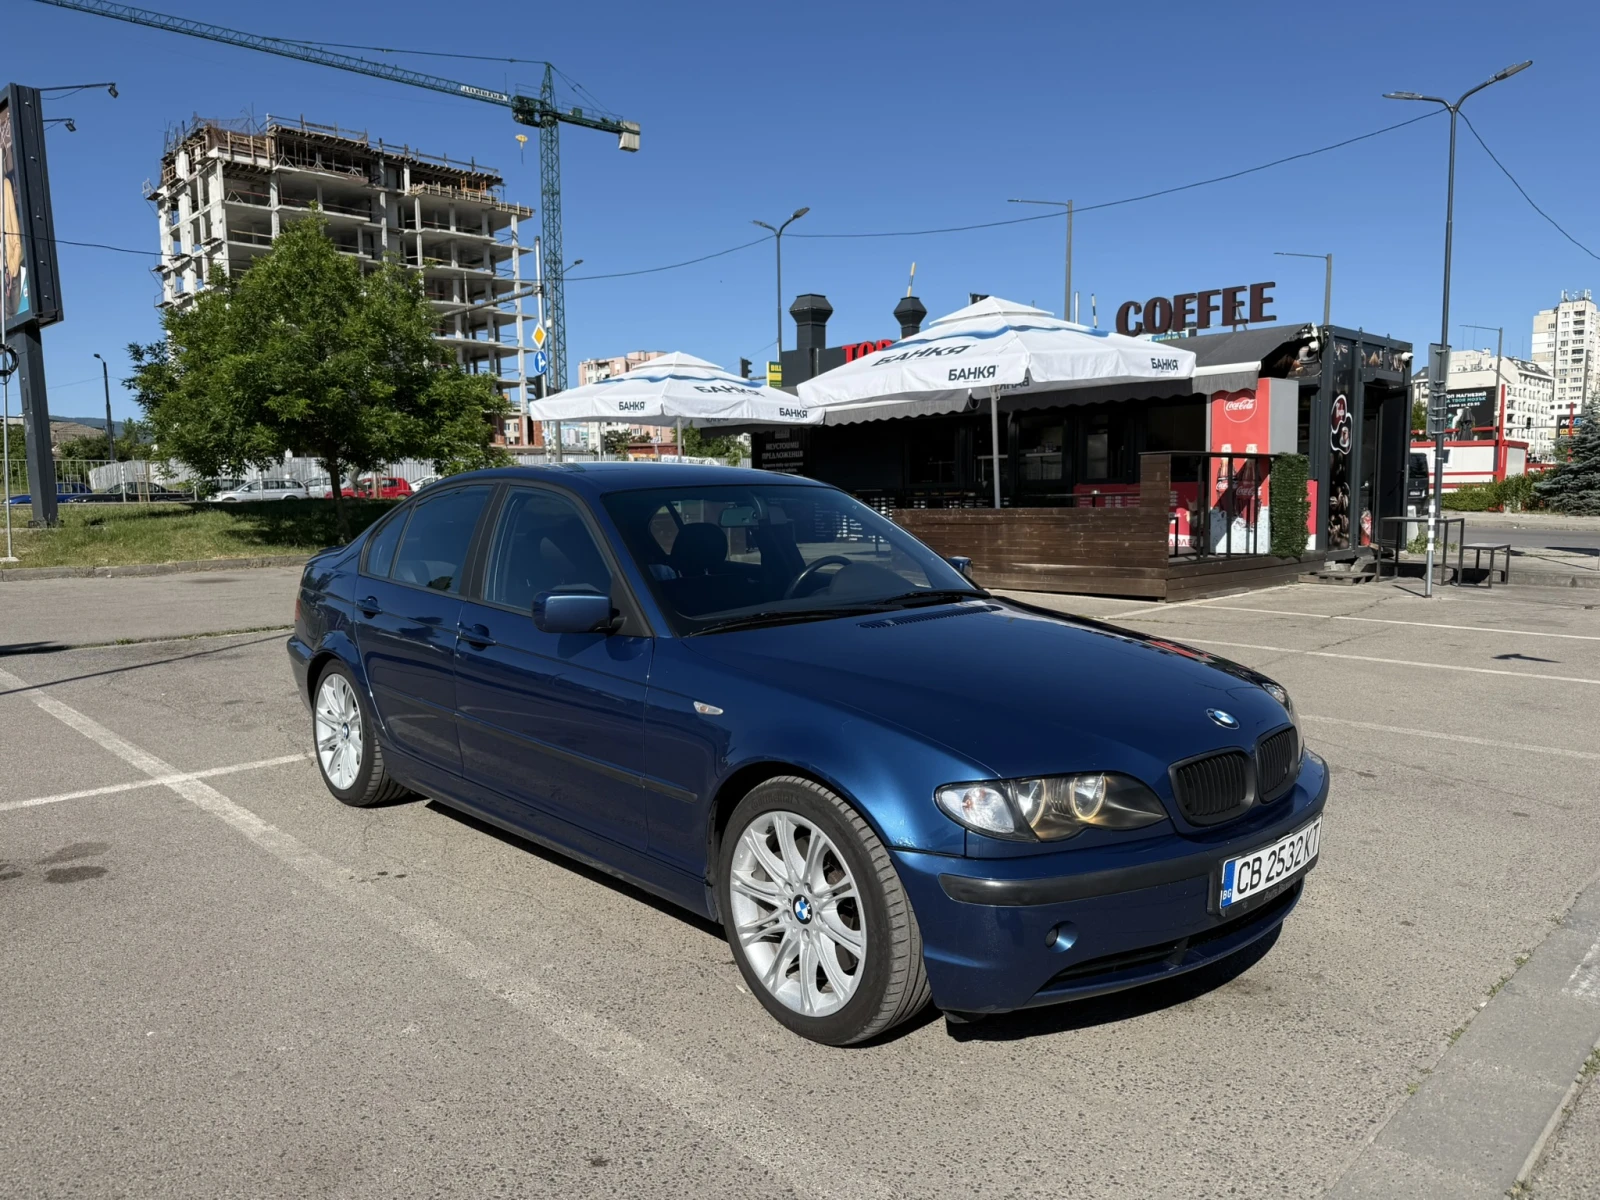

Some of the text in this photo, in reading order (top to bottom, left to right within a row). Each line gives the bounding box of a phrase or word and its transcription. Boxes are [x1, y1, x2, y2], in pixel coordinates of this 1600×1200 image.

[1116, 281, 1277, 337] COFFEE
[872, 345, 972, 366] БАНКЯ
[1151, 358, 1178, 370] БАНКЯ
[948, 365, 997, 381] БАНКЯ
[619, 401, 645, 411] БАНКЯ
[1226, 399, 1255, 411] Coca-Cola
[779, 407, 808, 418] БАНКЯ
[1237, 857, 1262, 894] CB
[1265, 836, 1303, 883] 2532
[1303, 822, 1320, 860] KT
[1222, 889, 1232, 900] BG
